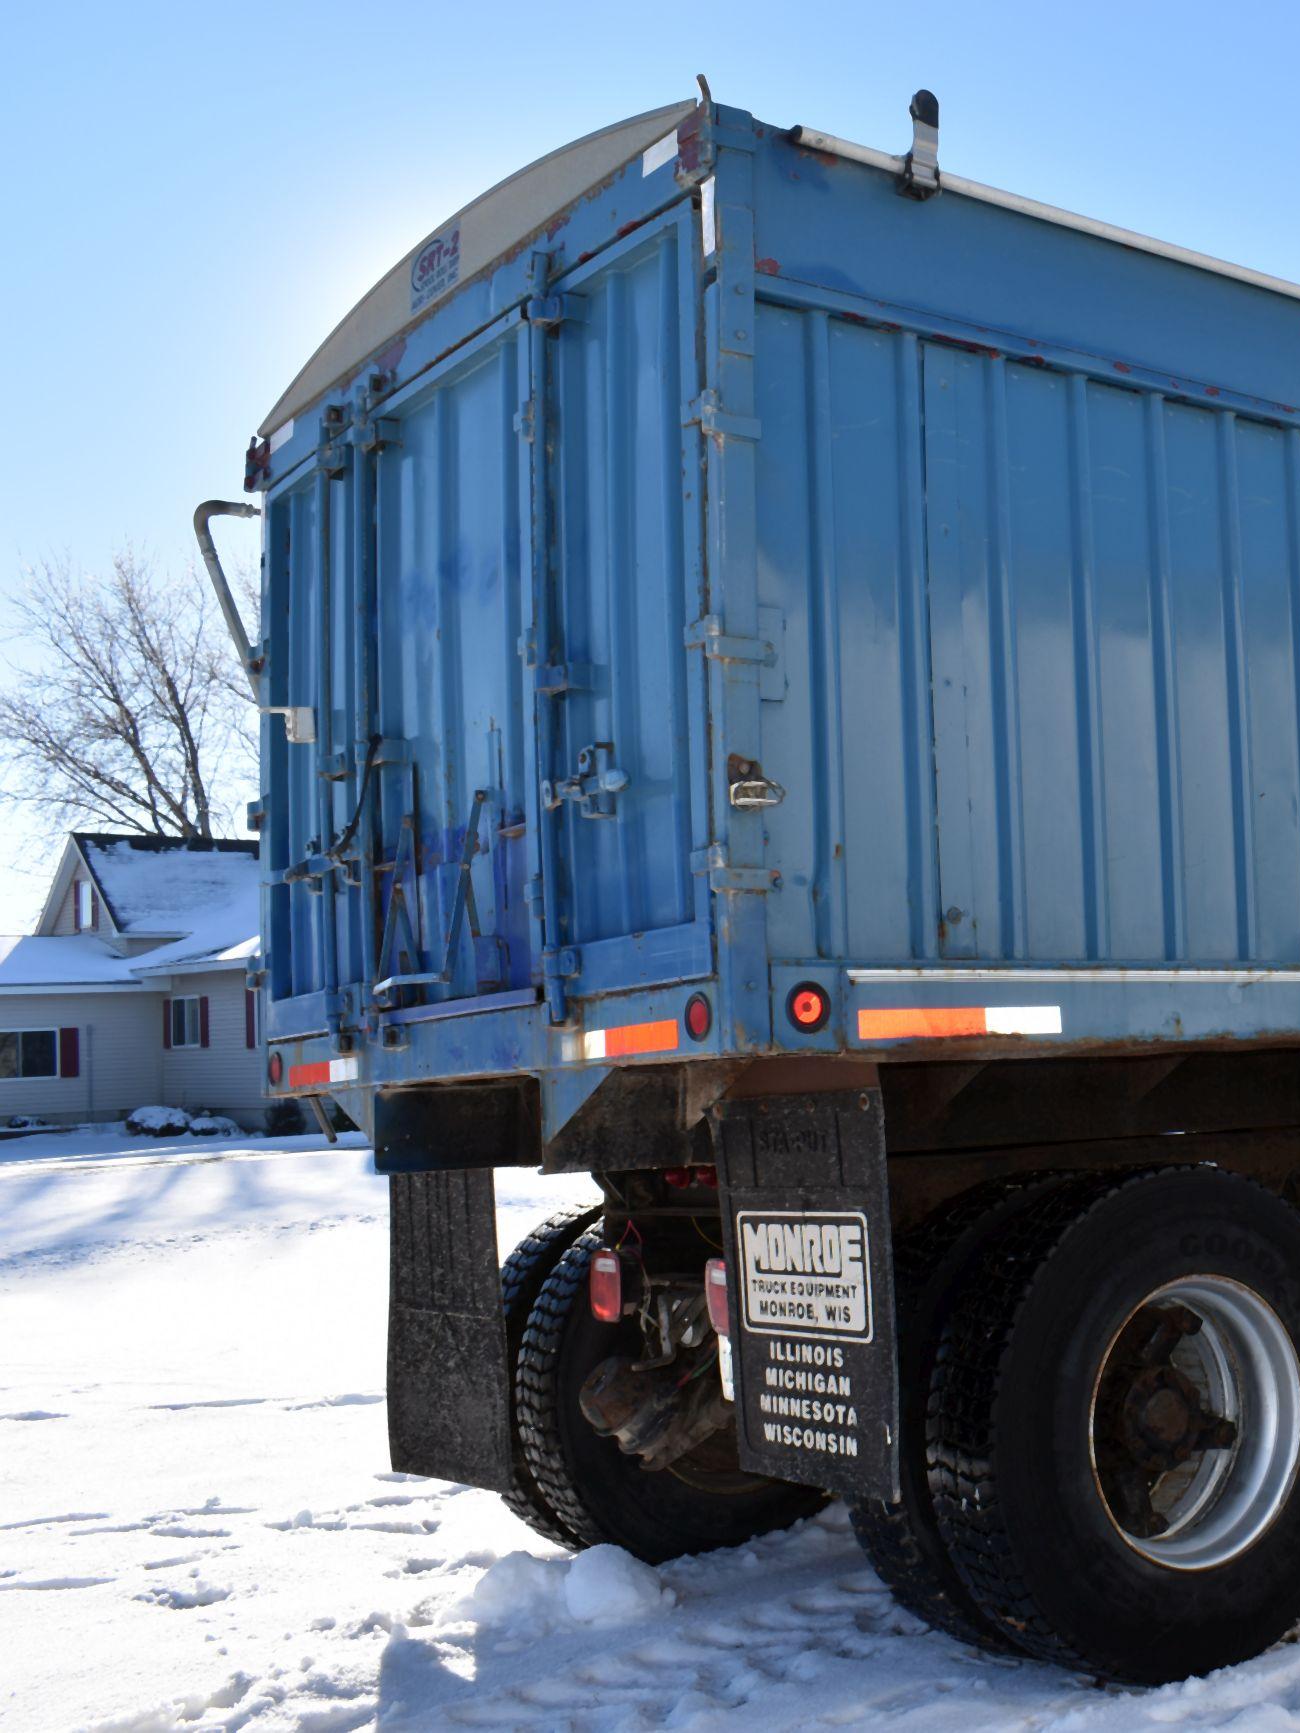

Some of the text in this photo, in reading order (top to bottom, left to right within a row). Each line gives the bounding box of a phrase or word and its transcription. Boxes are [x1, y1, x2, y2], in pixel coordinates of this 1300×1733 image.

[743, 1223, 863, 1274] MONROE
[752, 1279, 858, 1299] TRUCK EQUIPMENT
[759, 1300, 851, 1323] MONROE, WIS
[769, 1341, 844, 1368] ILLINOIS
[765, 1367, 851, 1396] MICHIGAN
[760, 1393, 858, 1427] MINNESOTA
[763, 1422, 858, 1457] WISCONSIN
